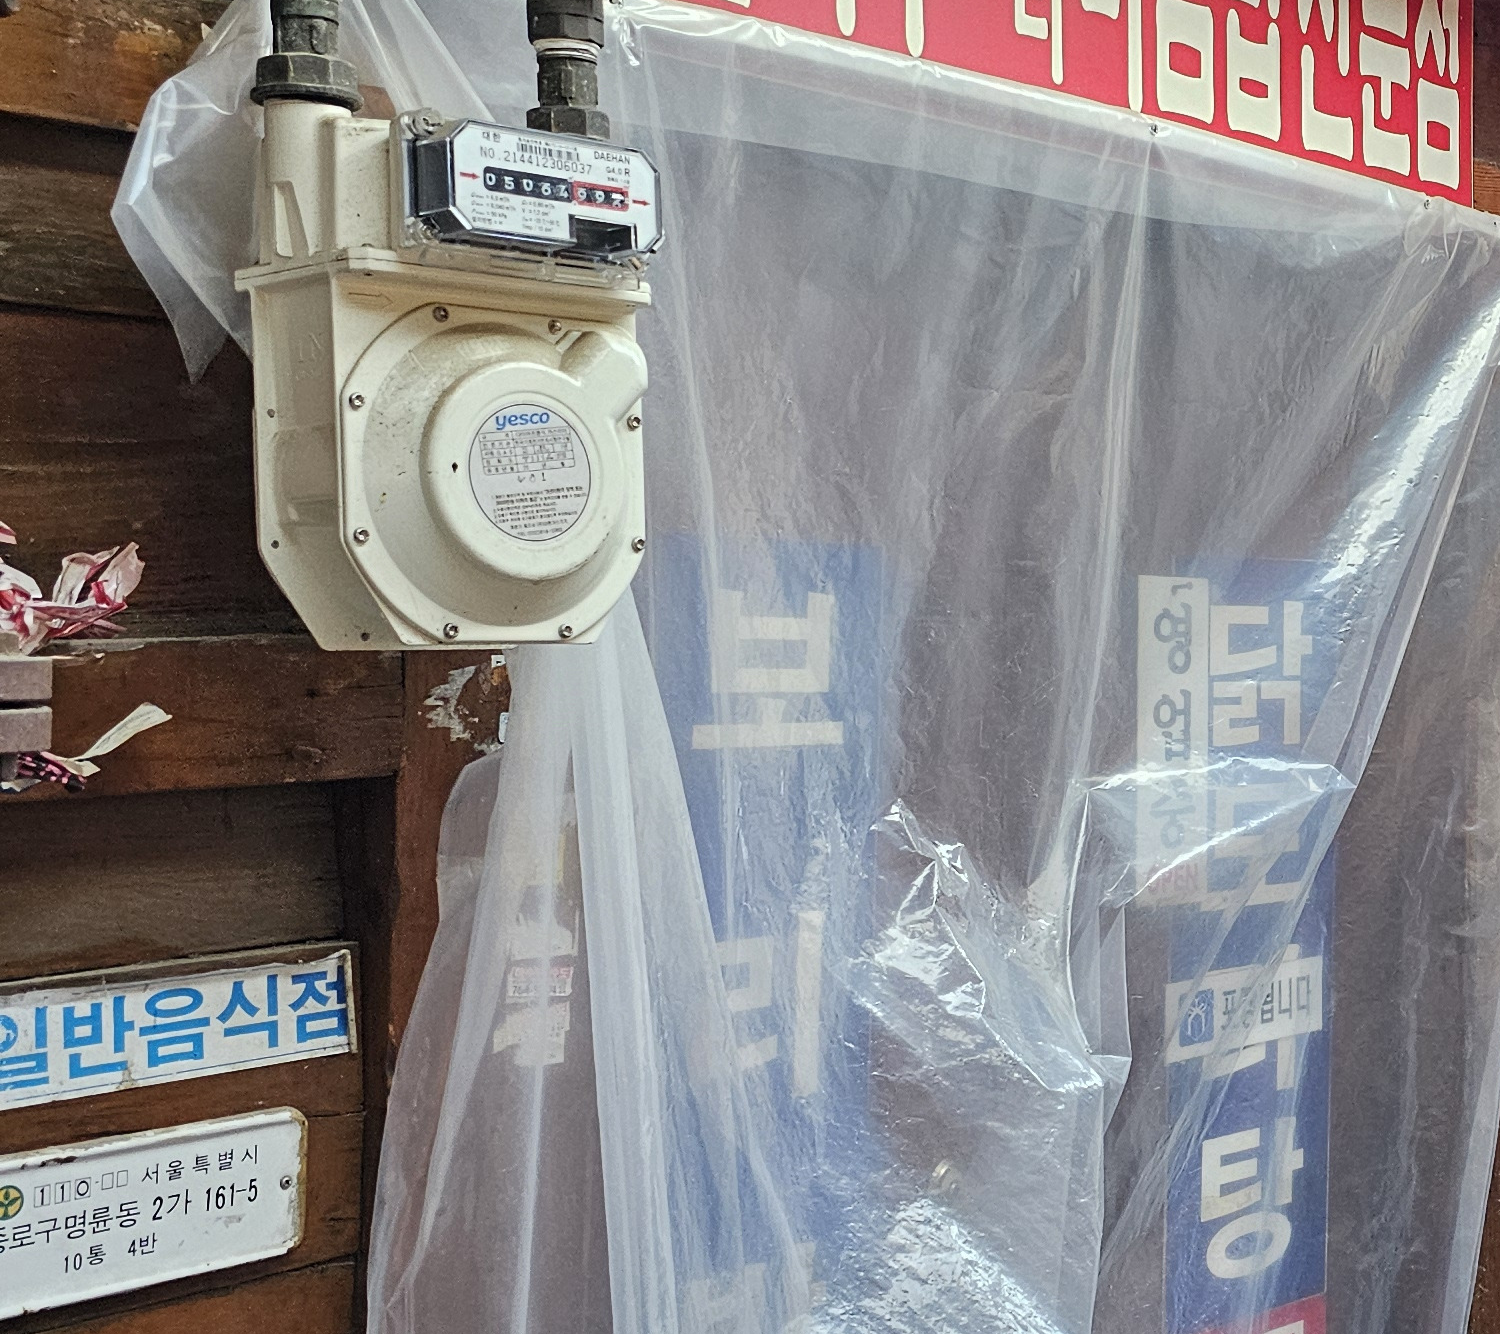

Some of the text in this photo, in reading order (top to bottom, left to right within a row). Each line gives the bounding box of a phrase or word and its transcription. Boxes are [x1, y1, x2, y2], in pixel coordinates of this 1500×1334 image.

[593, 151, 631, 165] DAEHAN
[495, 412, 550, 430] yesco
[0, 965, 350, 1093] 일반음식점
[141, 1144, 260, 1186] 서울특별시
[152, 1193, 192, 1222] 2가
[205, 1178, 259, 1213] 161-5
[63, 1236, 158, 1274] 10통 4반
